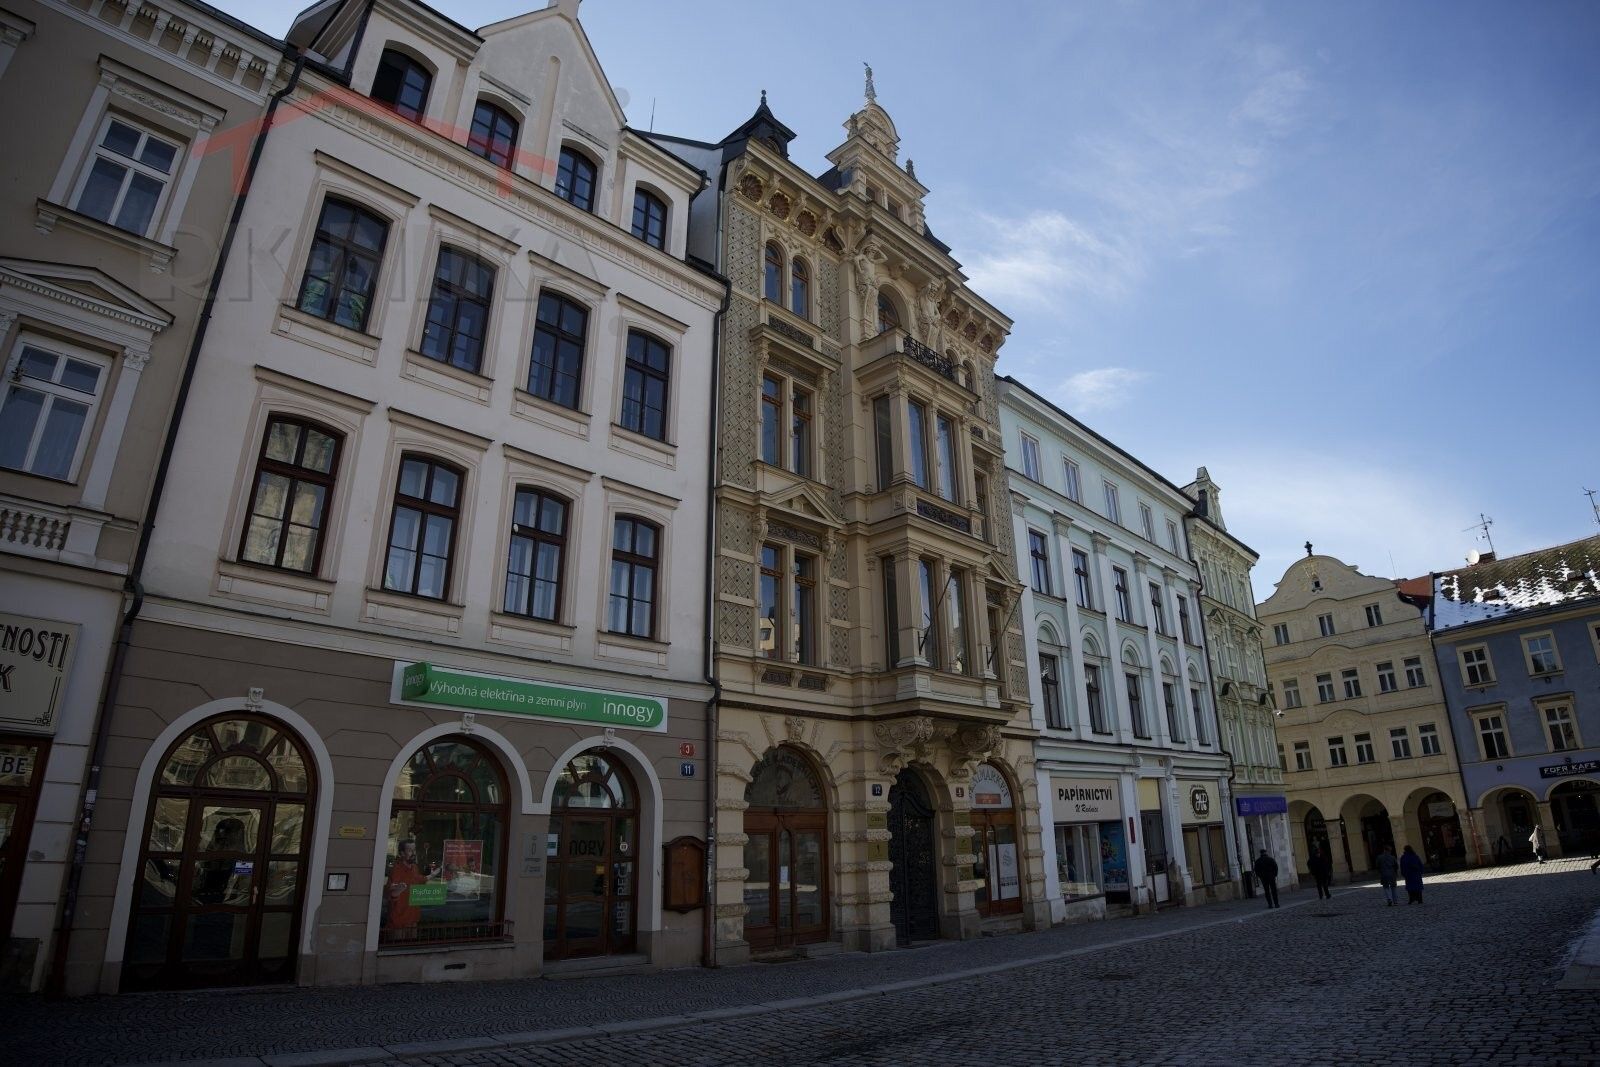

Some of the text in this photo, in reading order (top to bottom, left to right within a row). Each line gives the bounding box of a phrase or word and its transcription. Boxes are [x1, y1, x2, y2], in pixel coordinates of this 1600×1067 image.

[430, 680, 587, 712] Výhodná elektřina a zemní plyn
[602, 697, 655, 723] innogy
[682, 764, 693, 776] 11
[1058, 785, 1113, 801] PAPÍRNICTVÍ
